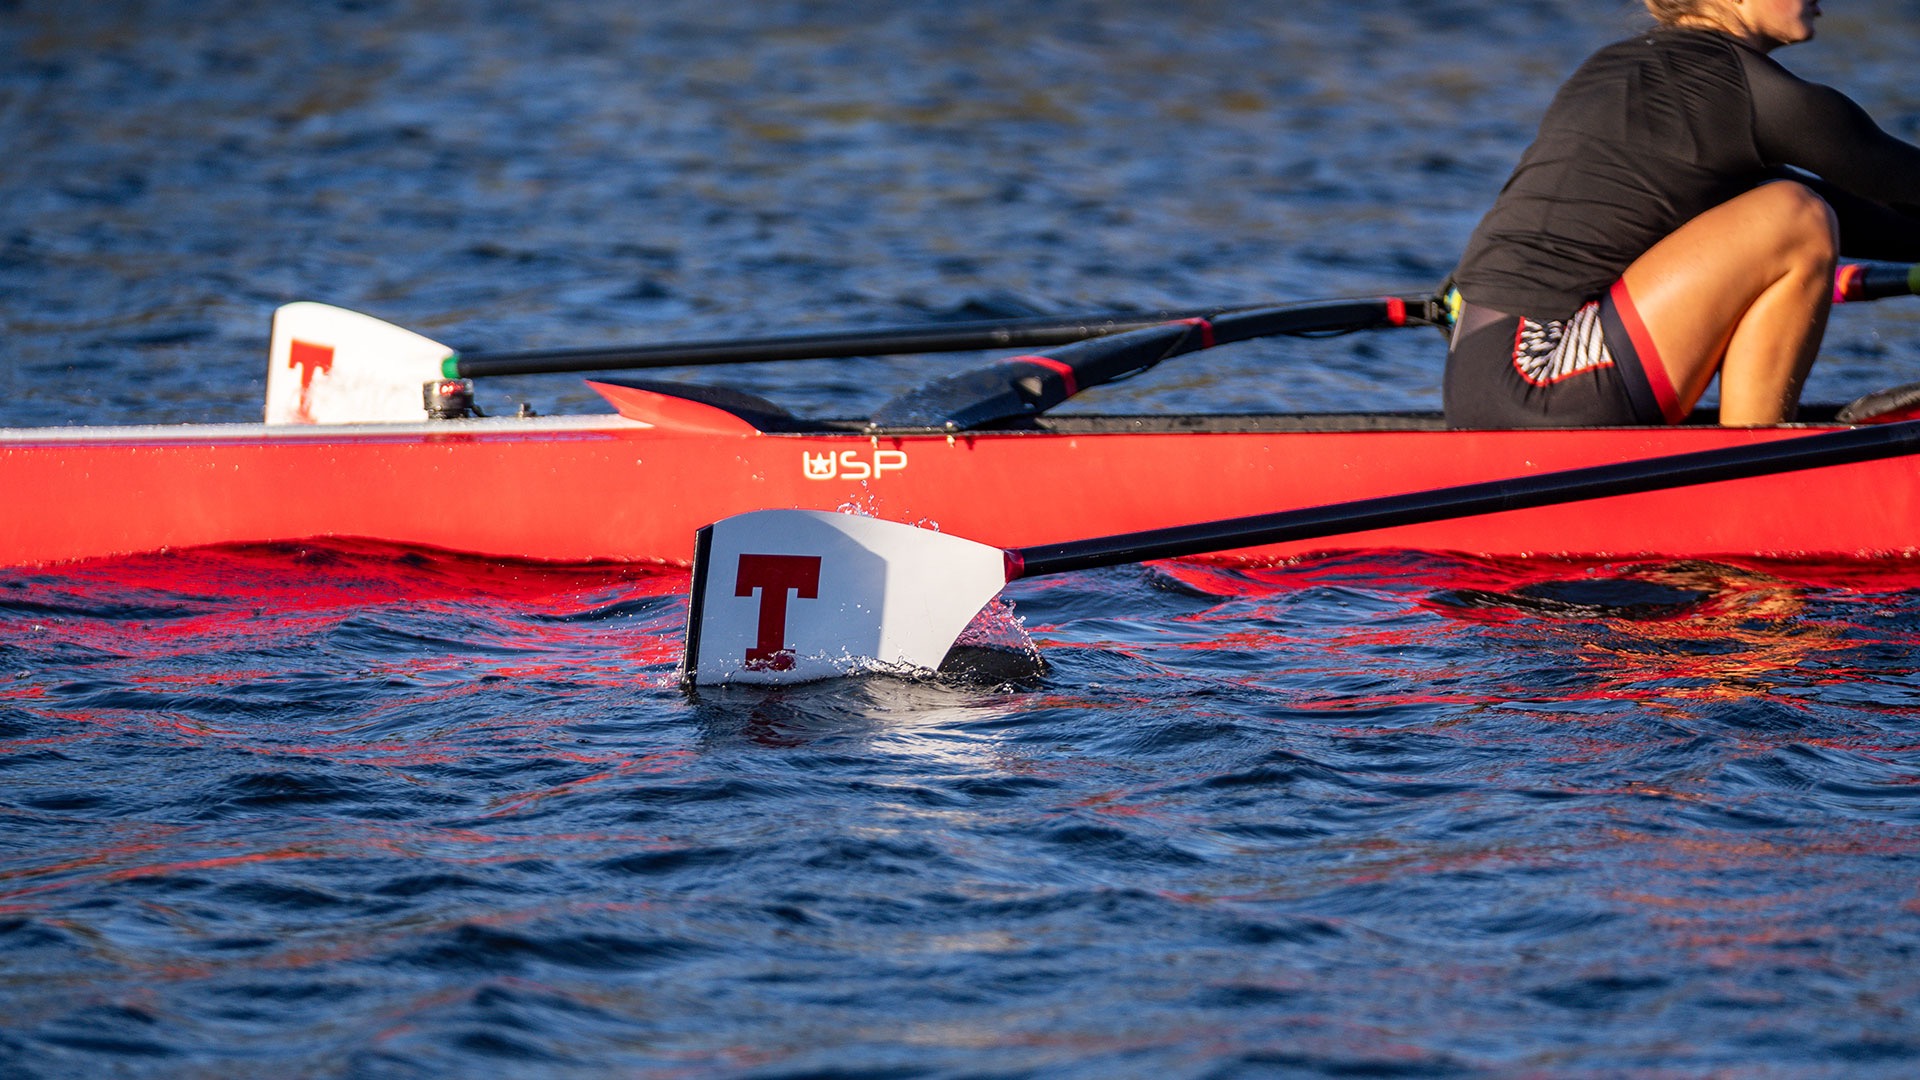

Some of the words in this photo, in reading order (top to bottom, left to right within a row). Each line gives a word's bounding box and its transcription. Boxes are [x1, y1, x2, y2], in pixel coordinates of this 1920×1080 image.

[289, 339, 334, 424] T
[803, 450, 908, 480] USP
[734, 553, 821, 671] T
